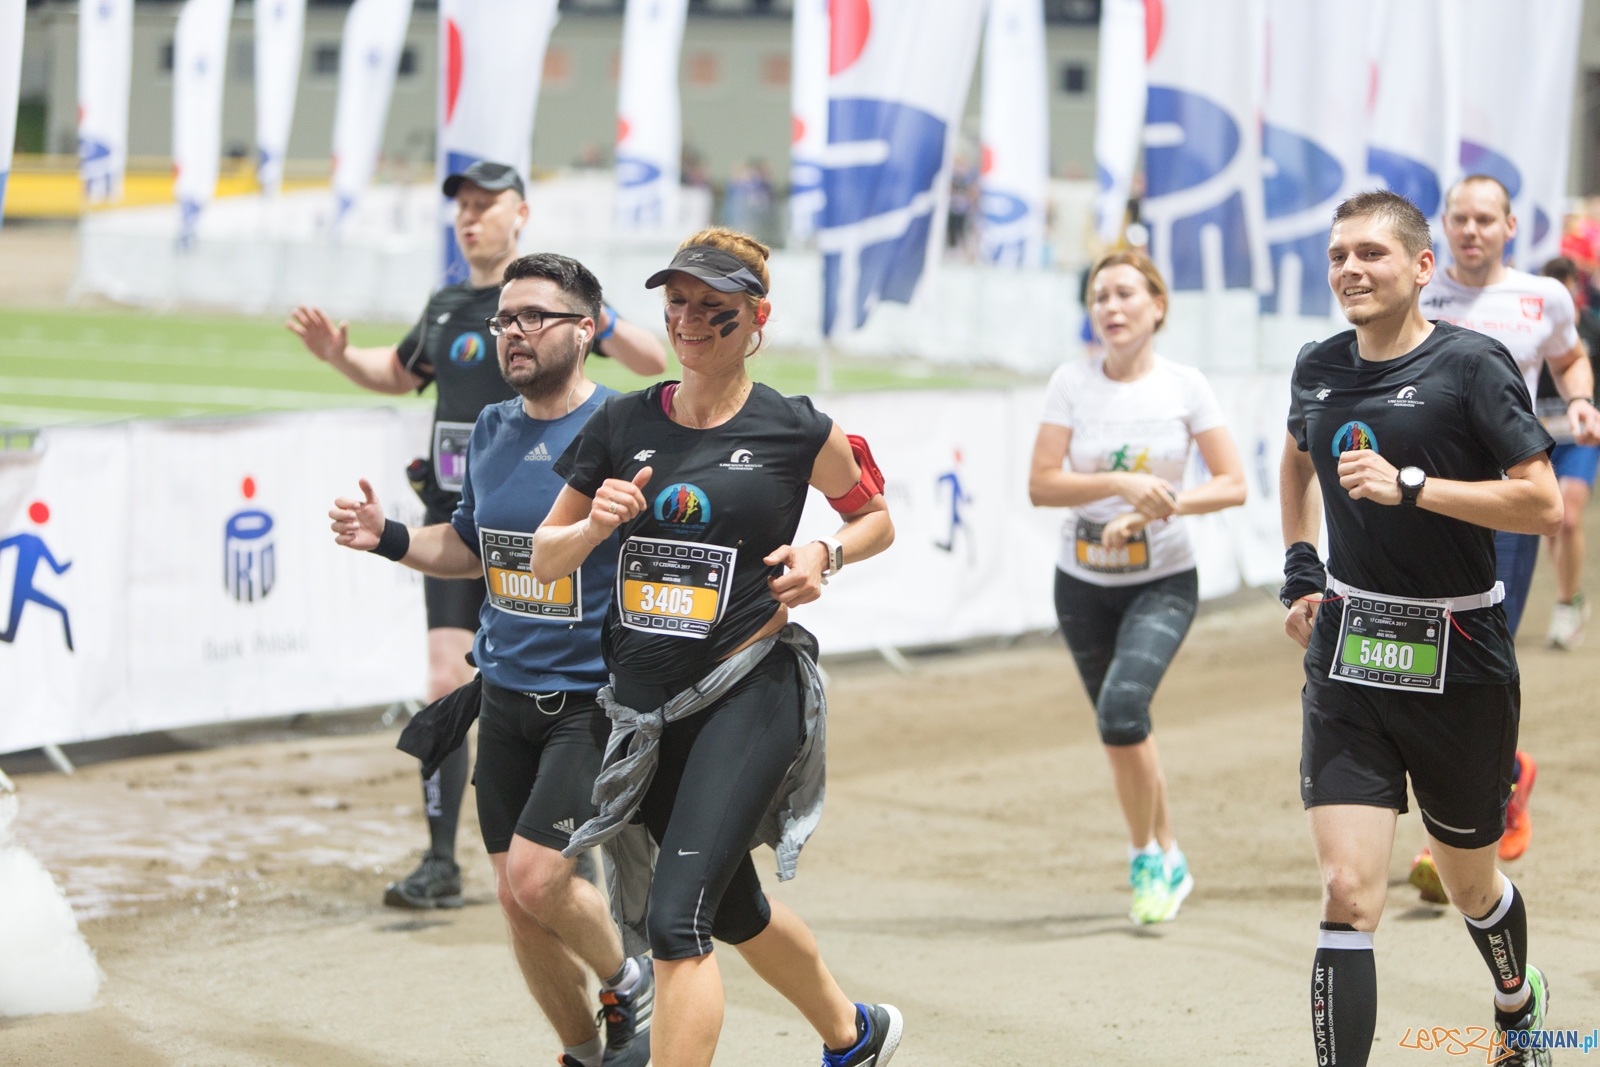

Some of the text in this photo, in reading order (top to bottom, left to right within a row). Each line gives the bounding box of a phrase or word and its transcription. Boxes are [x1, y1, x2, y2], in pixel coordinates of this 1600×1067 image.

[633, 449, 656, 462] 4F
[499, 571, 557, 600] 10007
[640, 584, 694, 615] 3405
[1360, 639, 1414, 670] 5480
